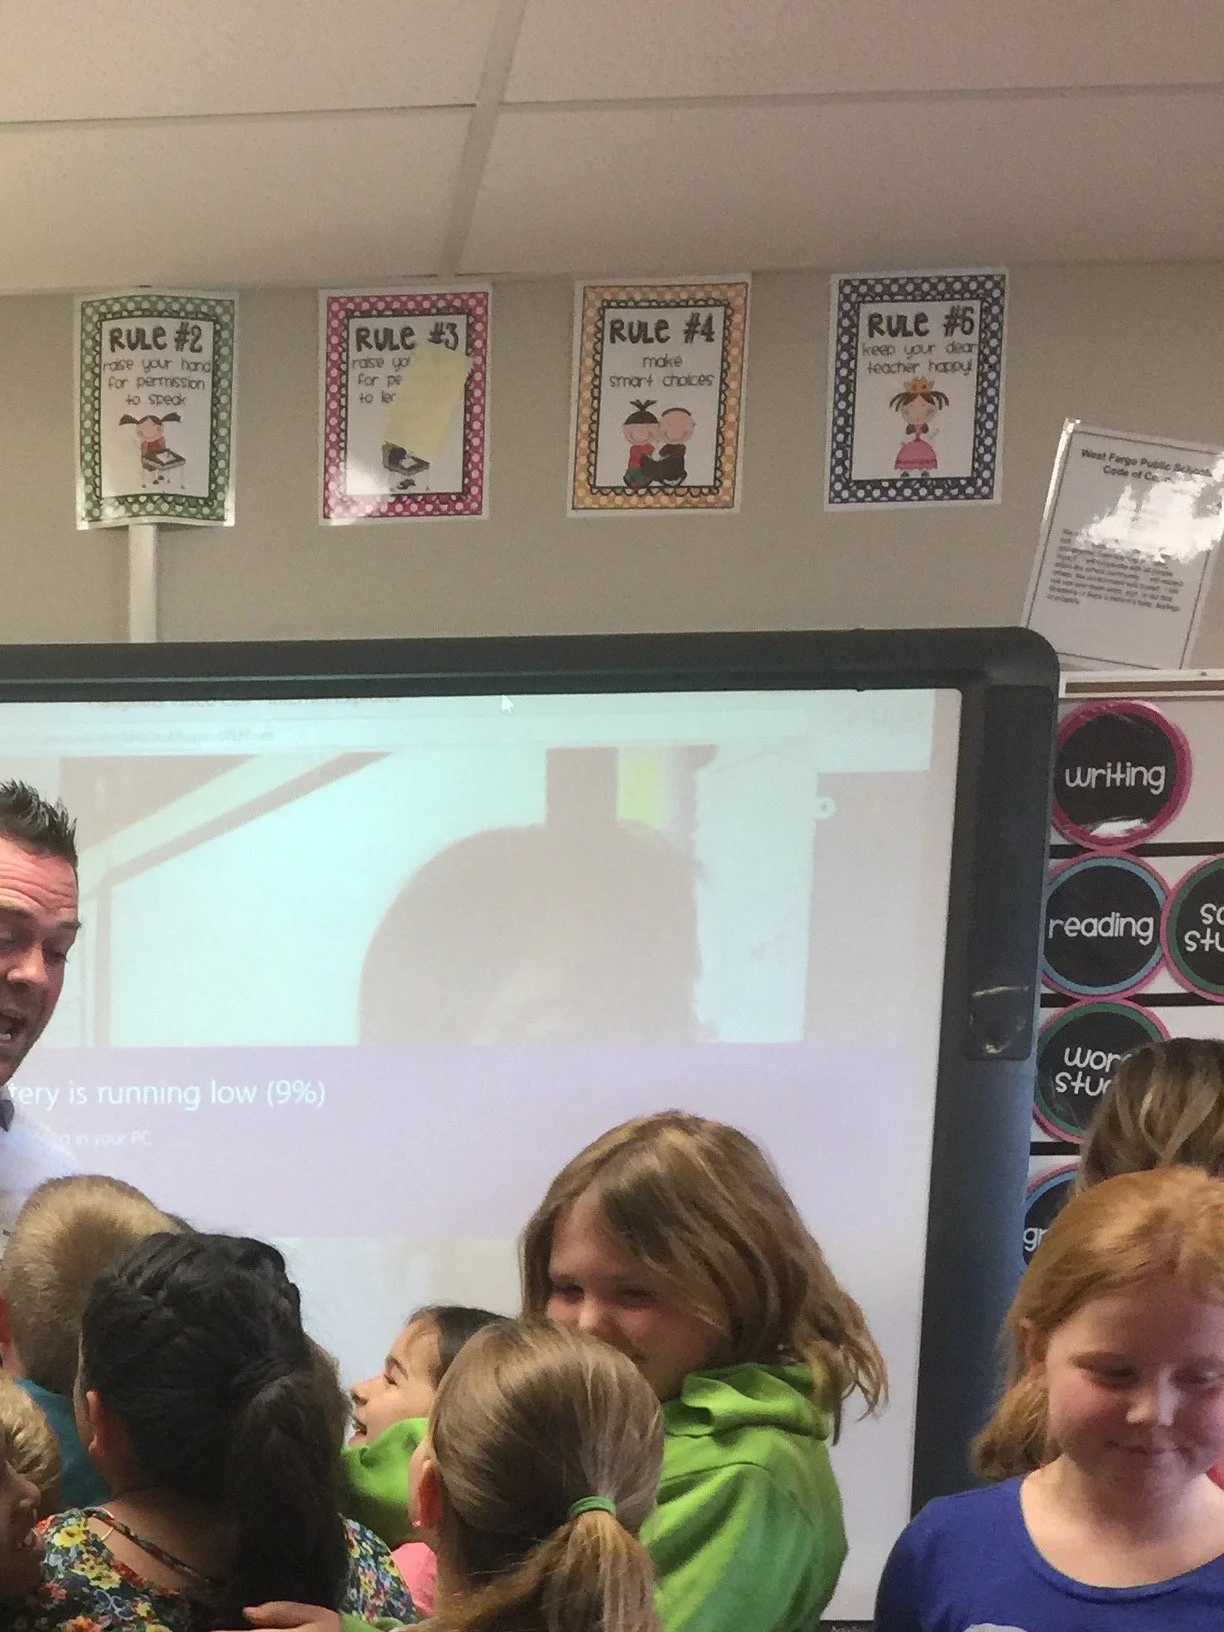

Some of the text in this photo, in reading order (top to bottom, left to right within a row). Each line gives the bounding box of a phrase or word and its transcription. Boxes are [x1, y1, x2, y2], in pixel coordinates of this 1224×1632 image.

[428, 322, 459, 351] #3
[683, 312, 715, 344] #4
[174, 322, 203, 353] #2
[862, 341, 978, 359] keep your dear
[103, 357, 211, 373] raise your hand
[352, 357, 384, 369] raise
[642, 353, 683, 368] make
[867, 361, 920, 374] teacher
[108, 376, 205, 390] for permission
[358, 373, 379, 386] for
[610, 372, 715, 388] smart choices
[126, 393, 186, 406] to speak
[359, 393, 373, 404] to
[1065, 762, 1166, 795] writing
[1048, 912, 1154, 946] reading
[1063, 1047, 1132, 1072] wor
[1055, 1071, 1112, 1096] stu
[69, 1080, 88, 1105] is
[98, 1081, 201, 1111] running
[211, 1080, 257, 1104] low
[267, 1080, 325, 1109] (9%)
